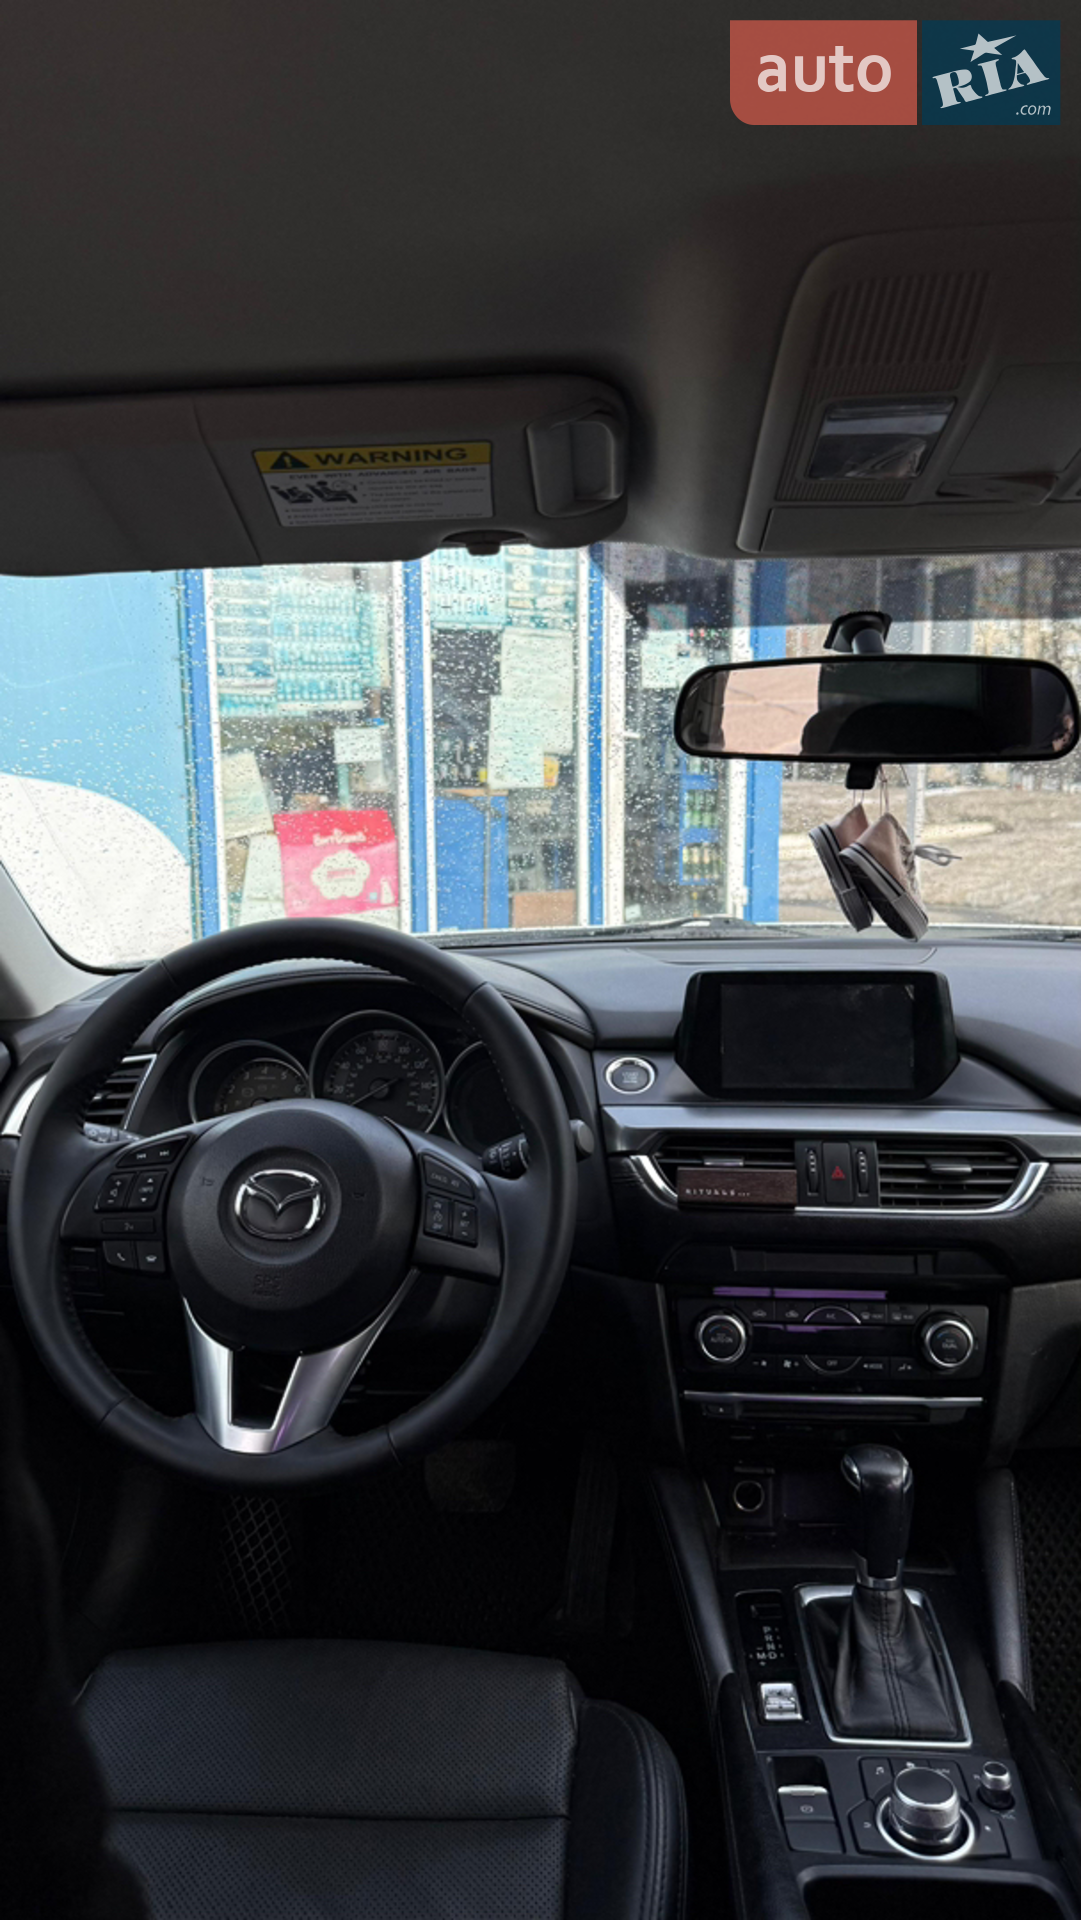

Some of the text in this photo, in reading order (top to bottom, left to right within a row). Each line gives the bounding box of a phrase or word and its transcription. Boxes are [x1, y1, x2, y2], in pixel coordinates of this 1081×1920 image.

[314, 447, 468, 467] WARNING
[358, 469, 418, 477] ADVANCED
[228, 1084, 236, 1094] 2
[293, 1084, 302, 1094] 6
